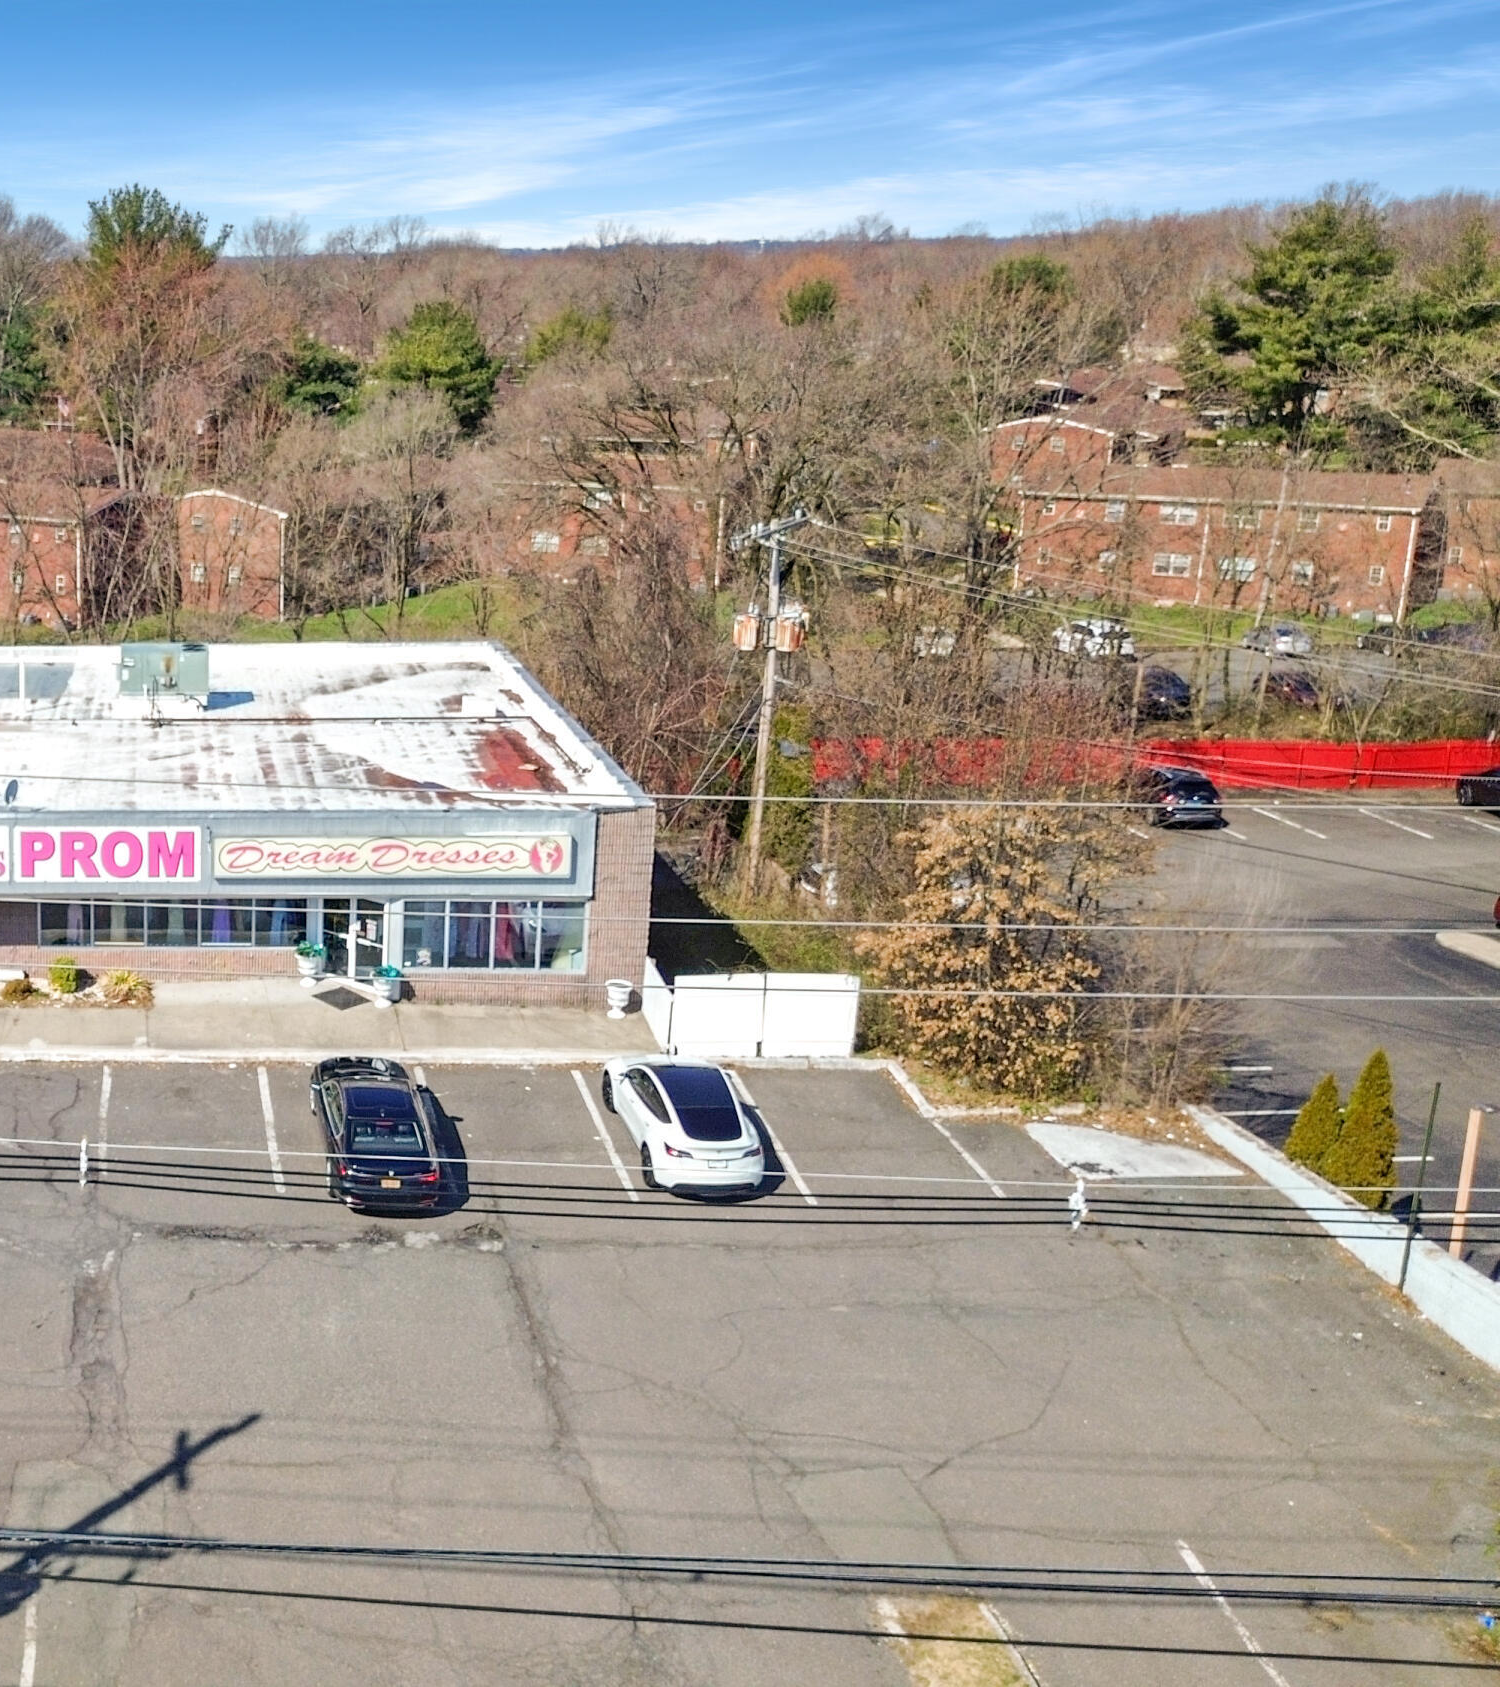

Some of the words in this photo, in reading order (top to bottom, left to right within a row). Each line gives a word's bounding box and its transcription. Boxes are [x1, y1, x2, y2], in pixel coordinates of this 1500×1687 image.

[20, 831, 195, 879] PROM
[226, 844, 359, 869] Dream
[371, 843, 518, 869] Dresses
